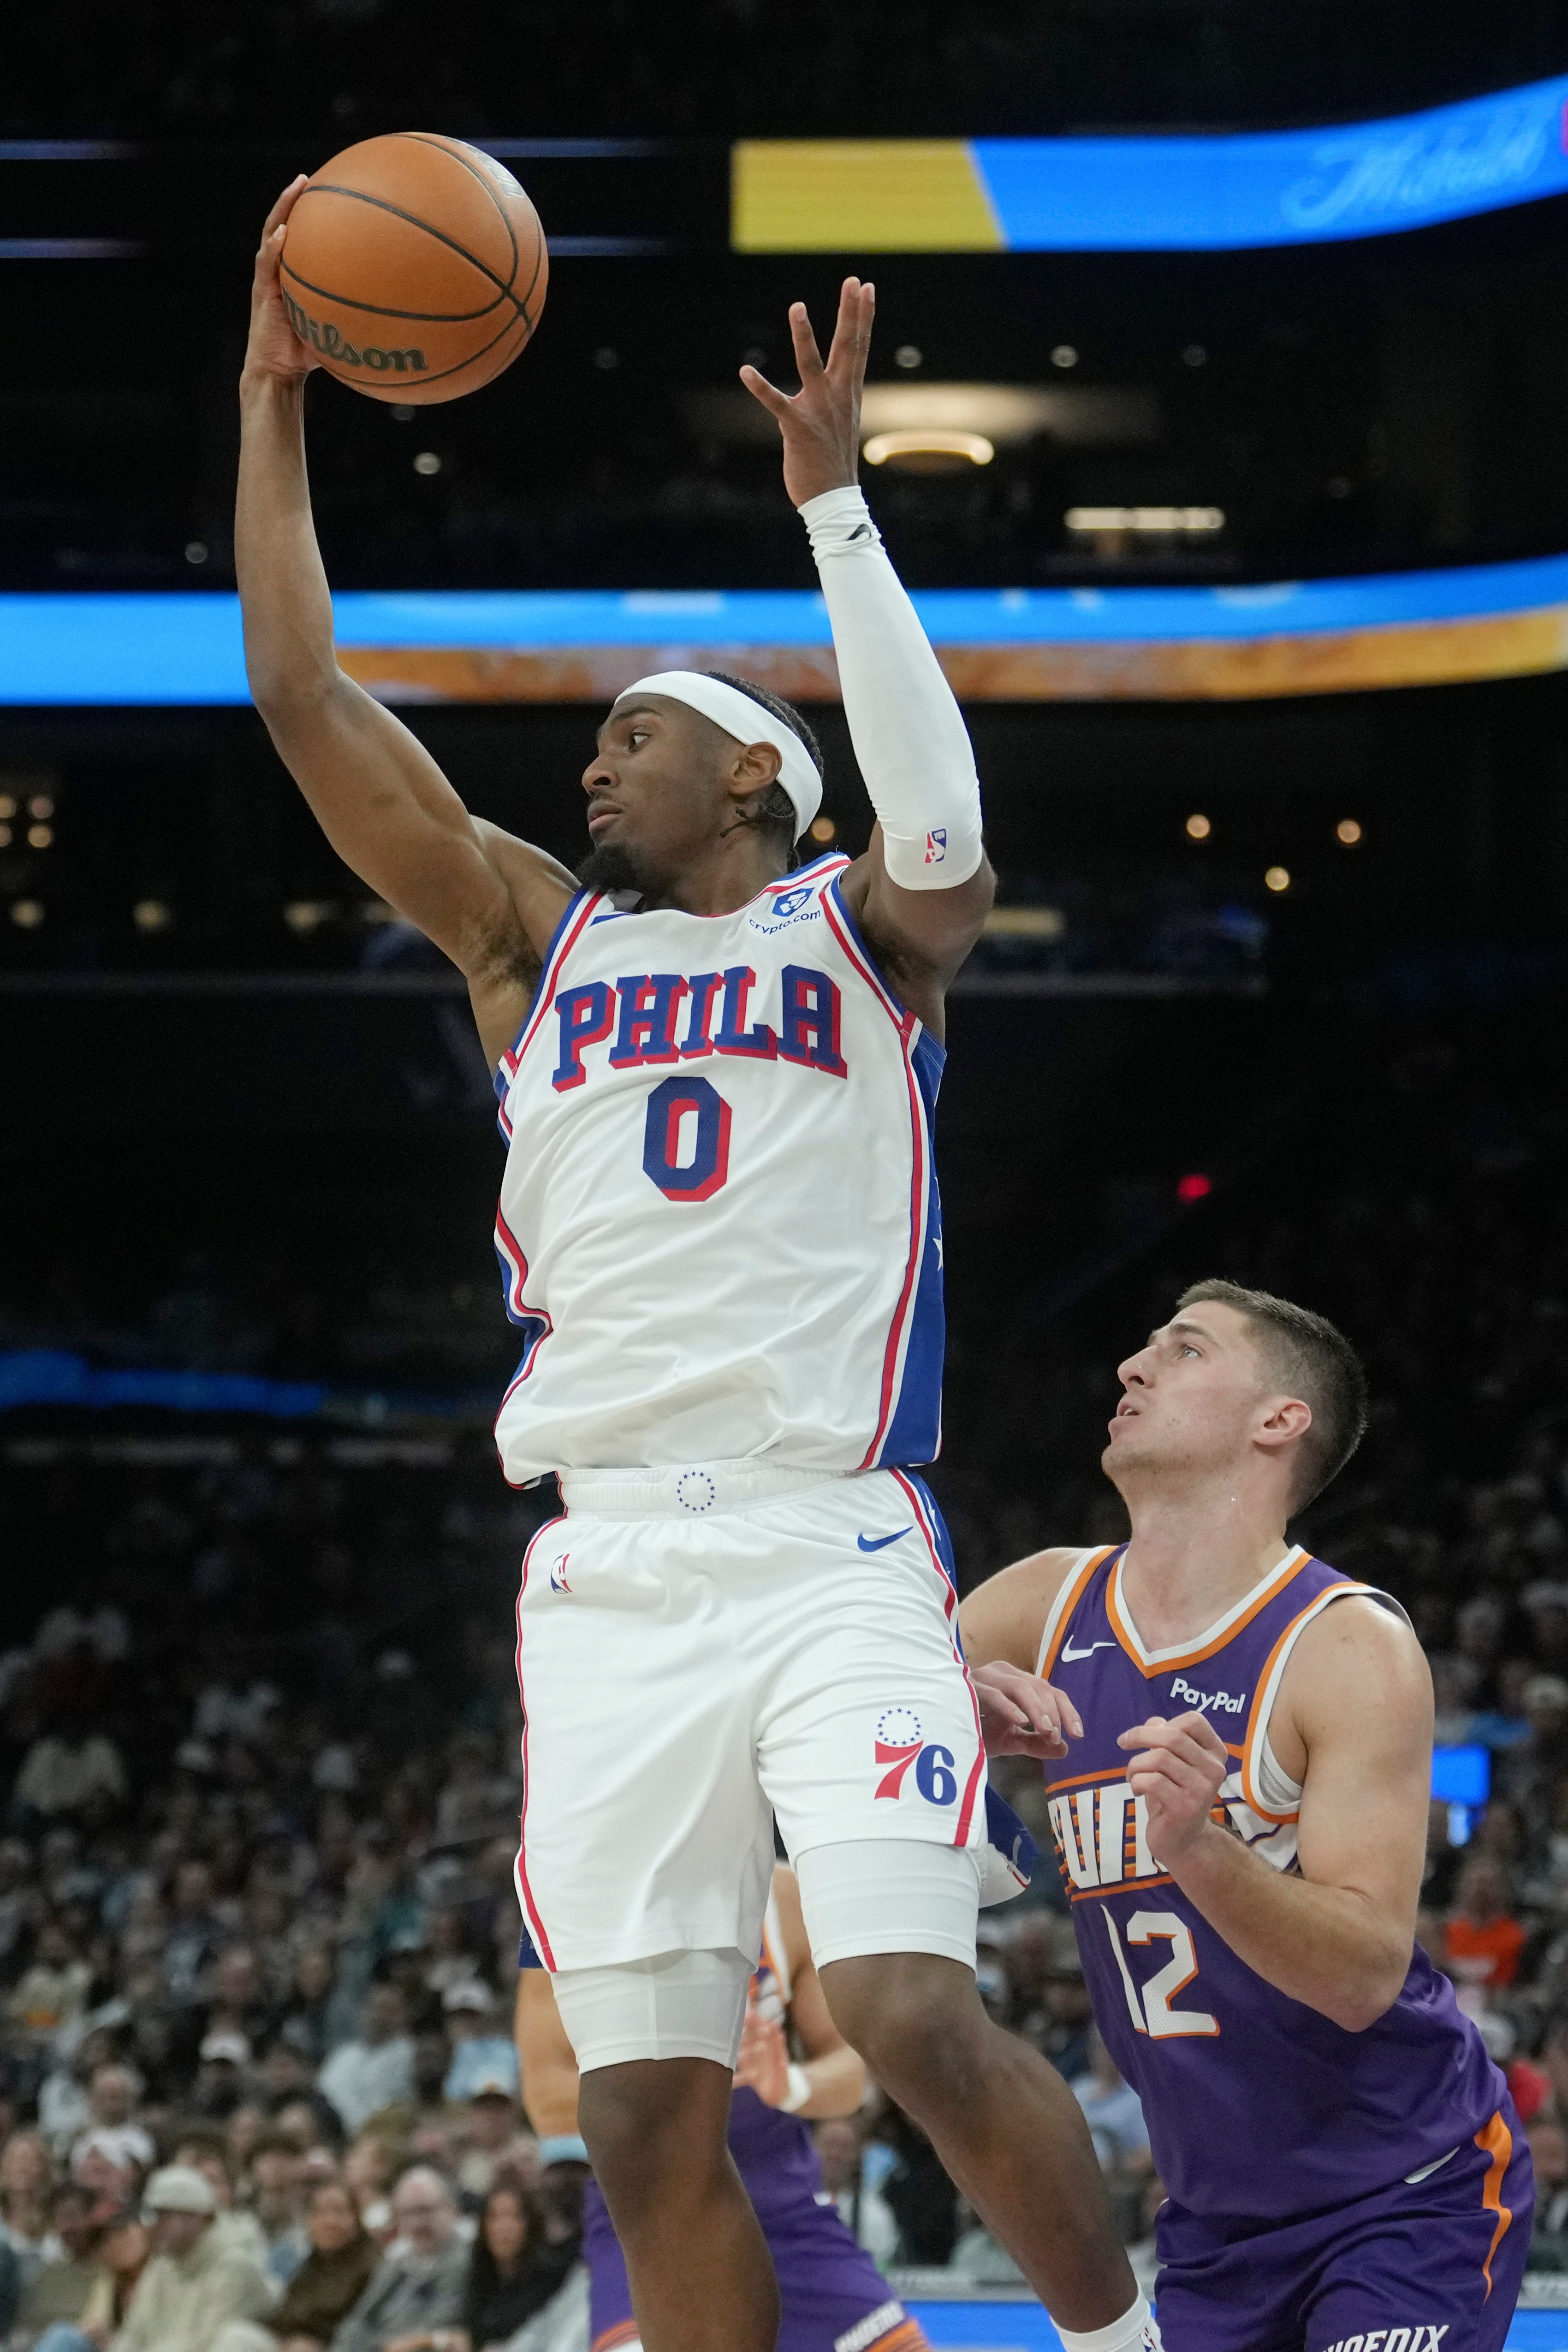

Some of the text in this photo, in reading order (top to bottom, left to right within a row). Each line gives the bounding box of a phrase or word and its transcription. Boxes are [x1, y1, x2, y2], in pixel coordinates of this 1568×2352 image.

[749, 910, 820, 935] crypto.com
[552, 964, 848, 1093] PHILA
[642, 1076, 732, 1202] 0
[1170, 1677, 1246, 1713] PayPal
[874, 1740, 957, 1806] 76
